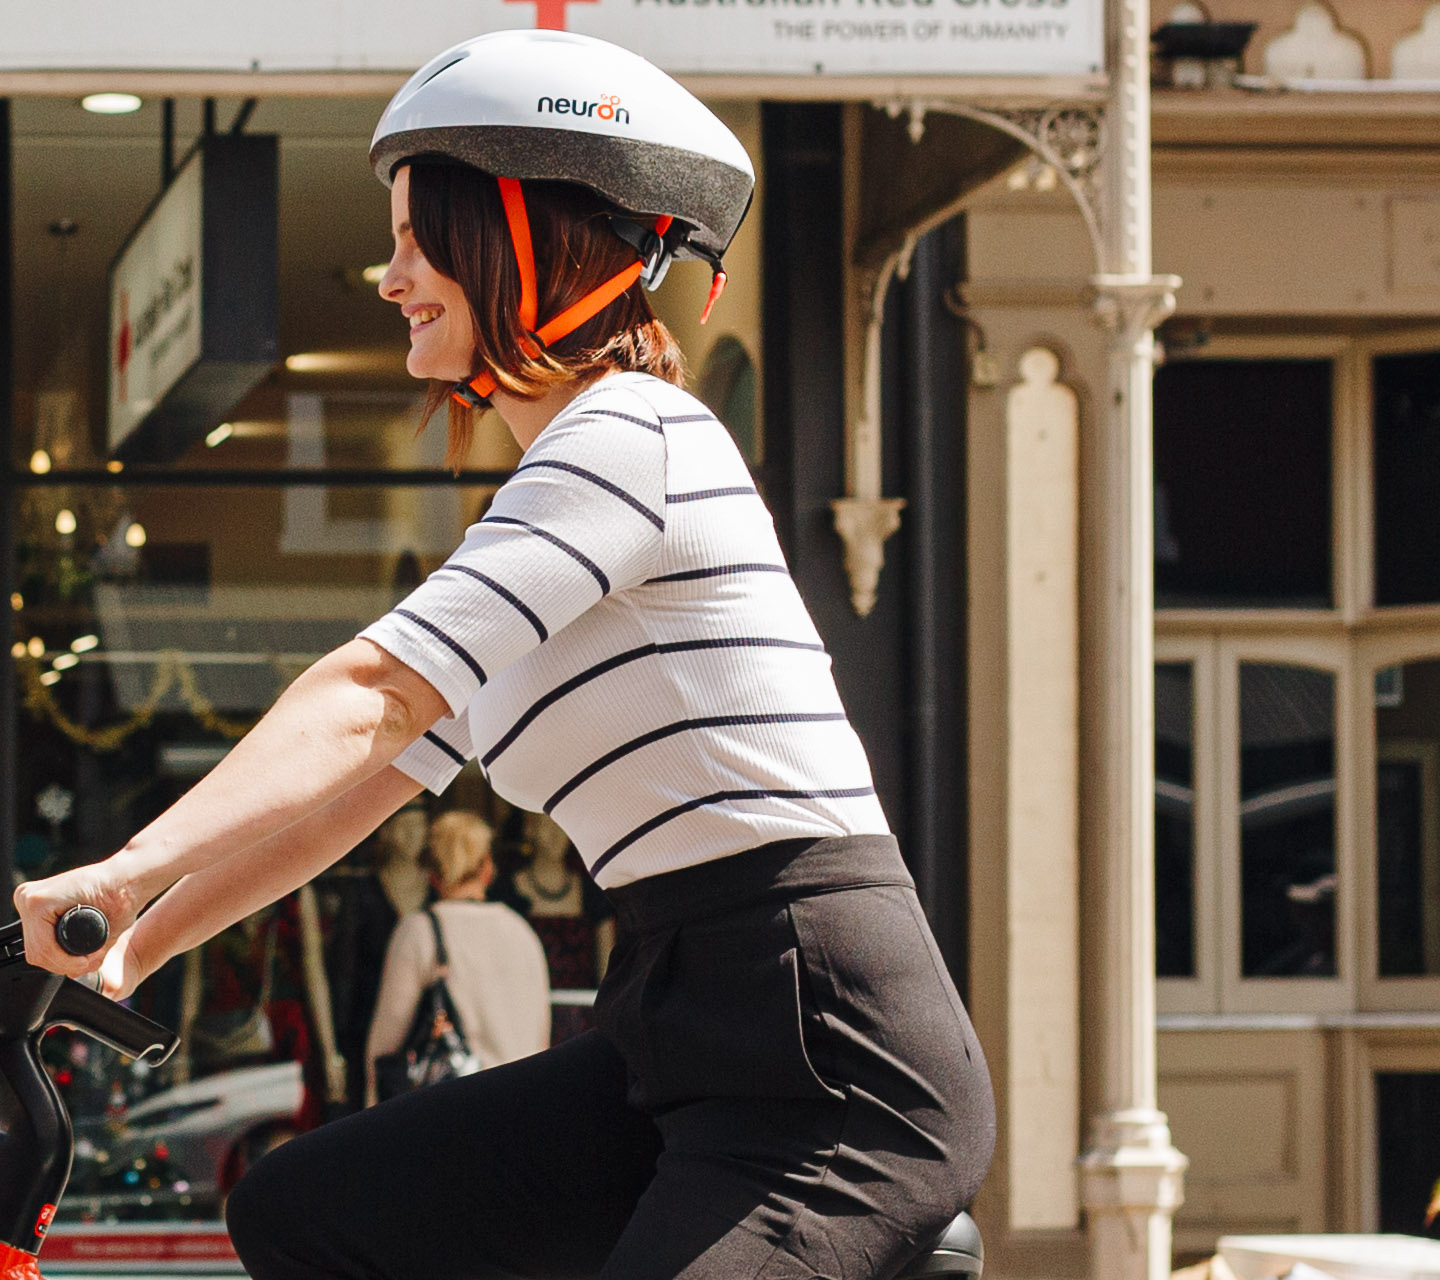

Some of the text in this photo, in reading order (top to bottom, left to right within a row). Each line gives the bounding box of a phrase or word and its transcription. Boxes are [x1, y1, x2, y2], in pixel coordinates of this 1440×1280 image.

[773, 20, 1069, 40] THE POWER OF HUMANITY
[537, 94, 630, 125] neuron
